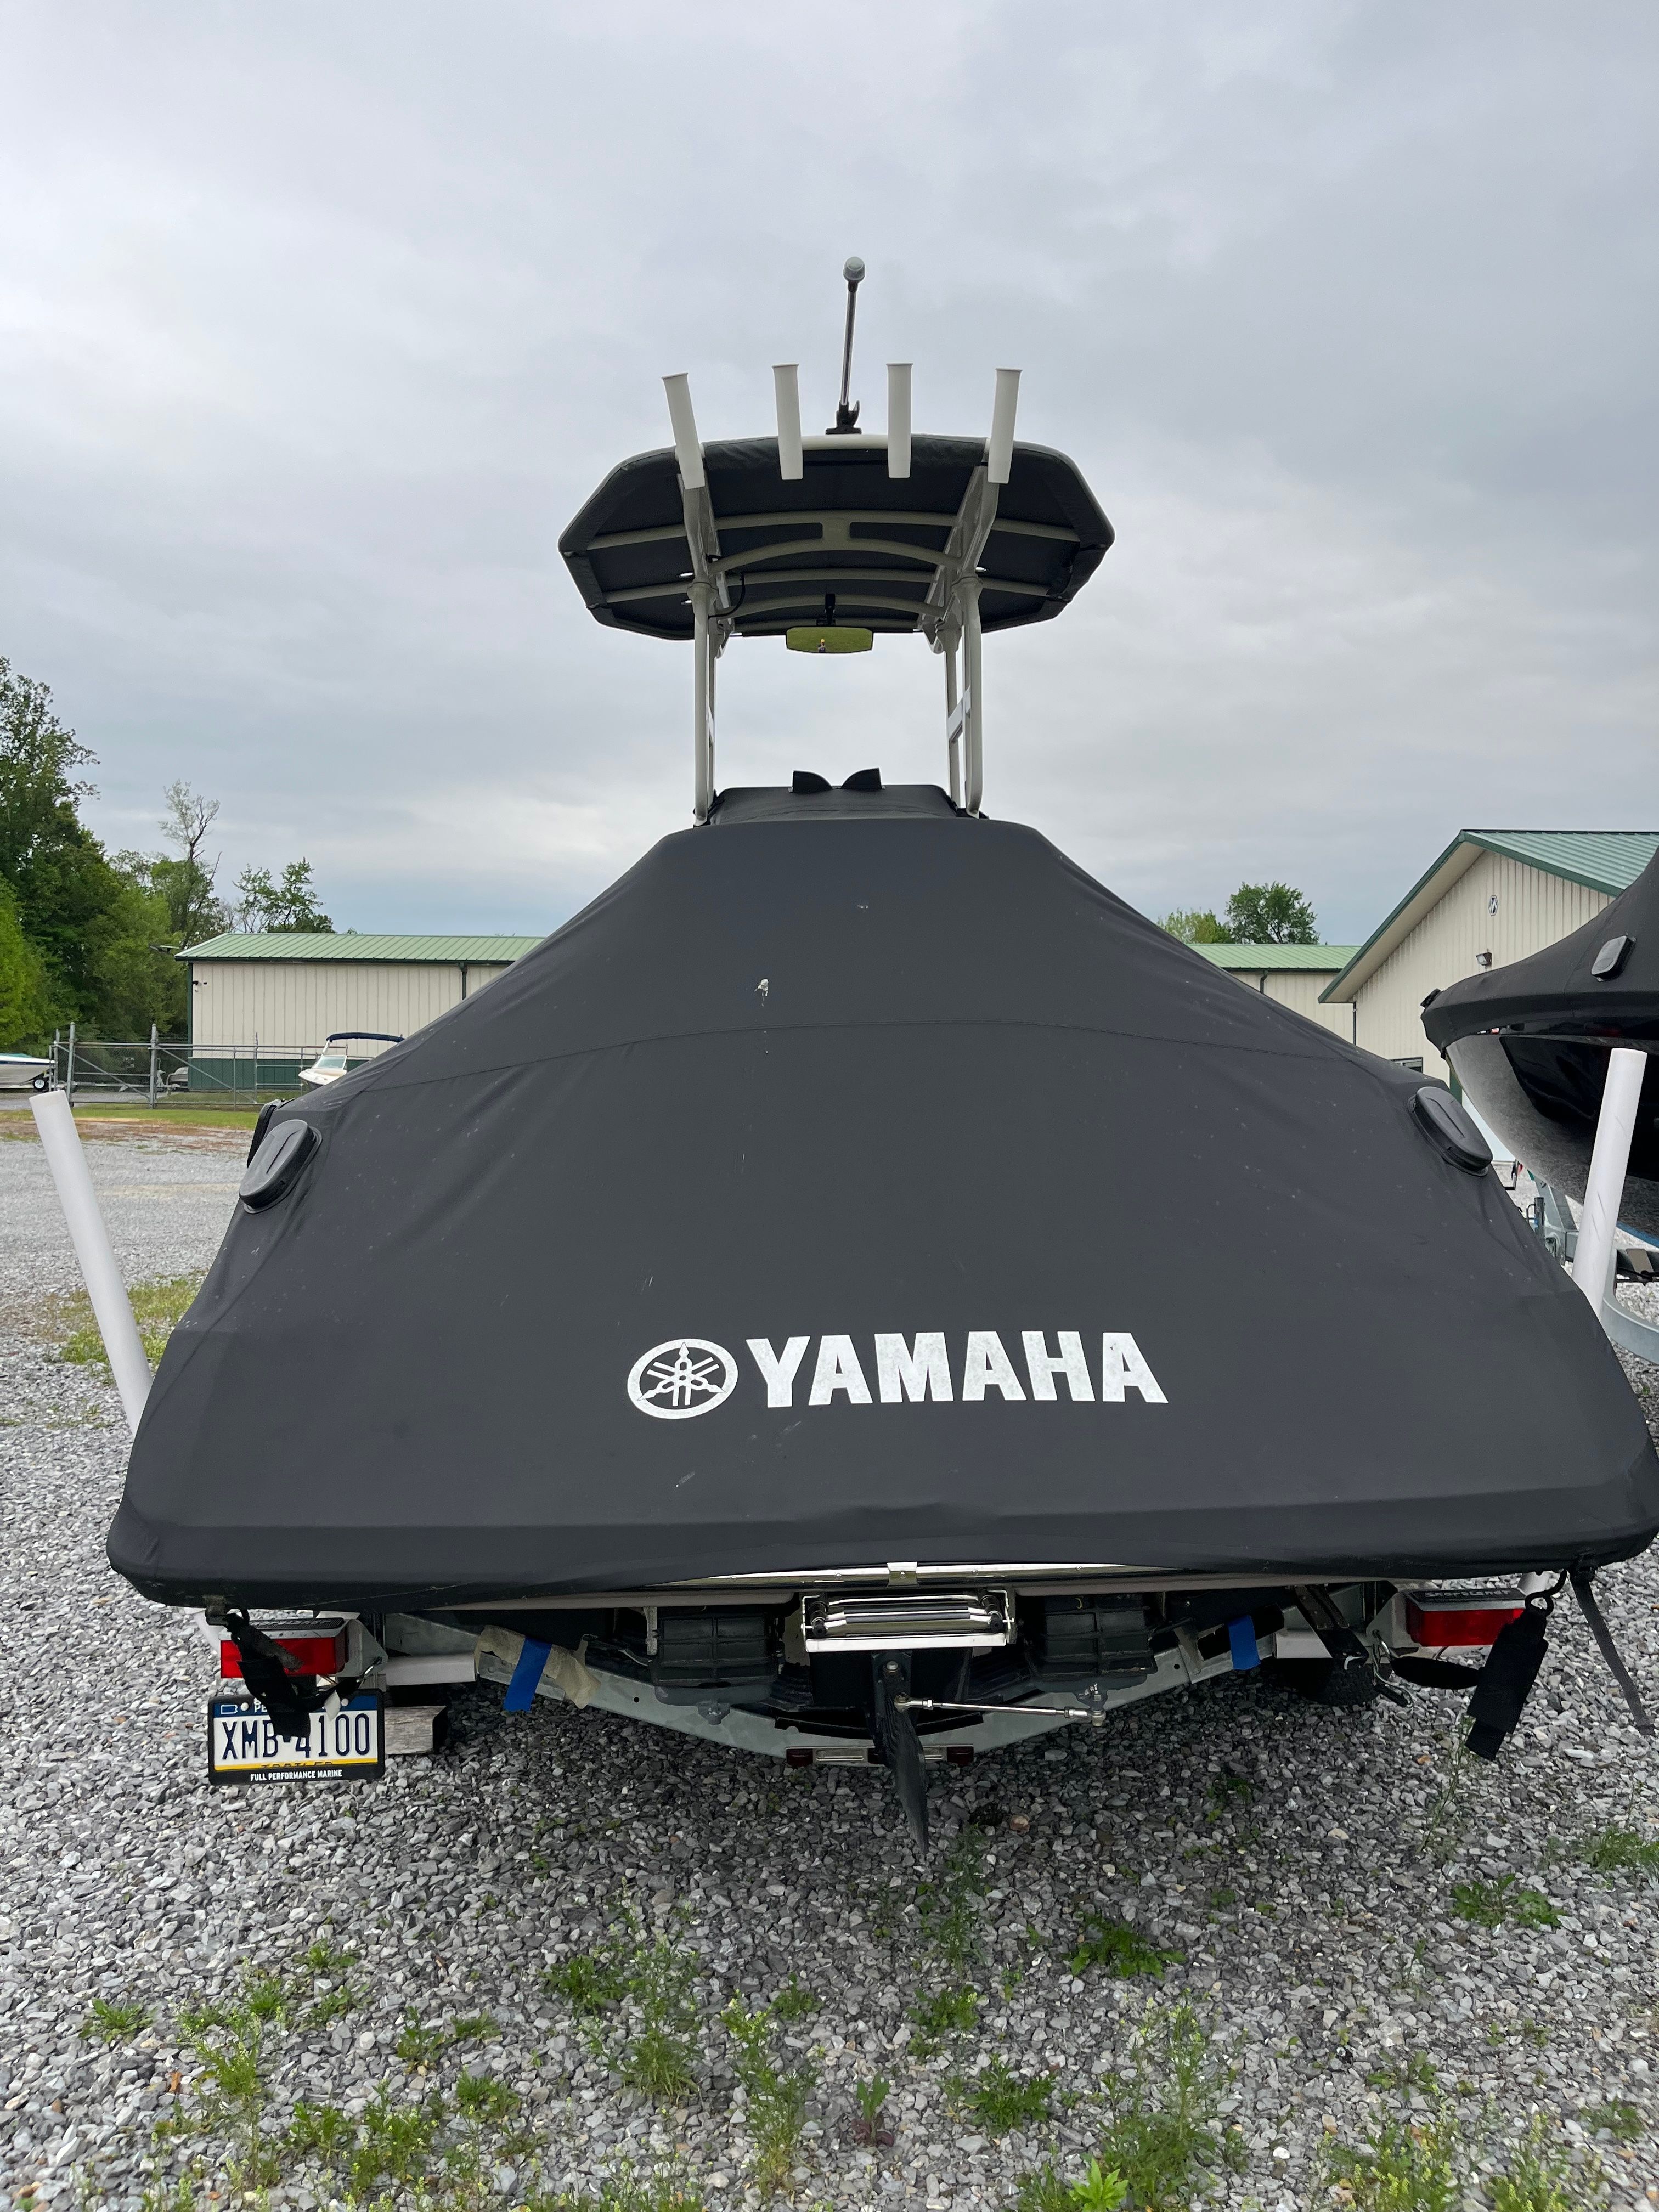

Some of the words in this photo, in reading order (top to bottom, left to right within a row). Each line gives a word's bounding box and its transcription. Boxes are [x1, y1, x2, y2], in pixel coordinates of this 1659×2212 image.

[746, 1331, 1169, 1408] YAMAHA
[250, 1773, 267, 1781] FULL
[268, 1770, 316, 1781] PERFORMANCE
[317, 1769, 343, 1778] MARINE
